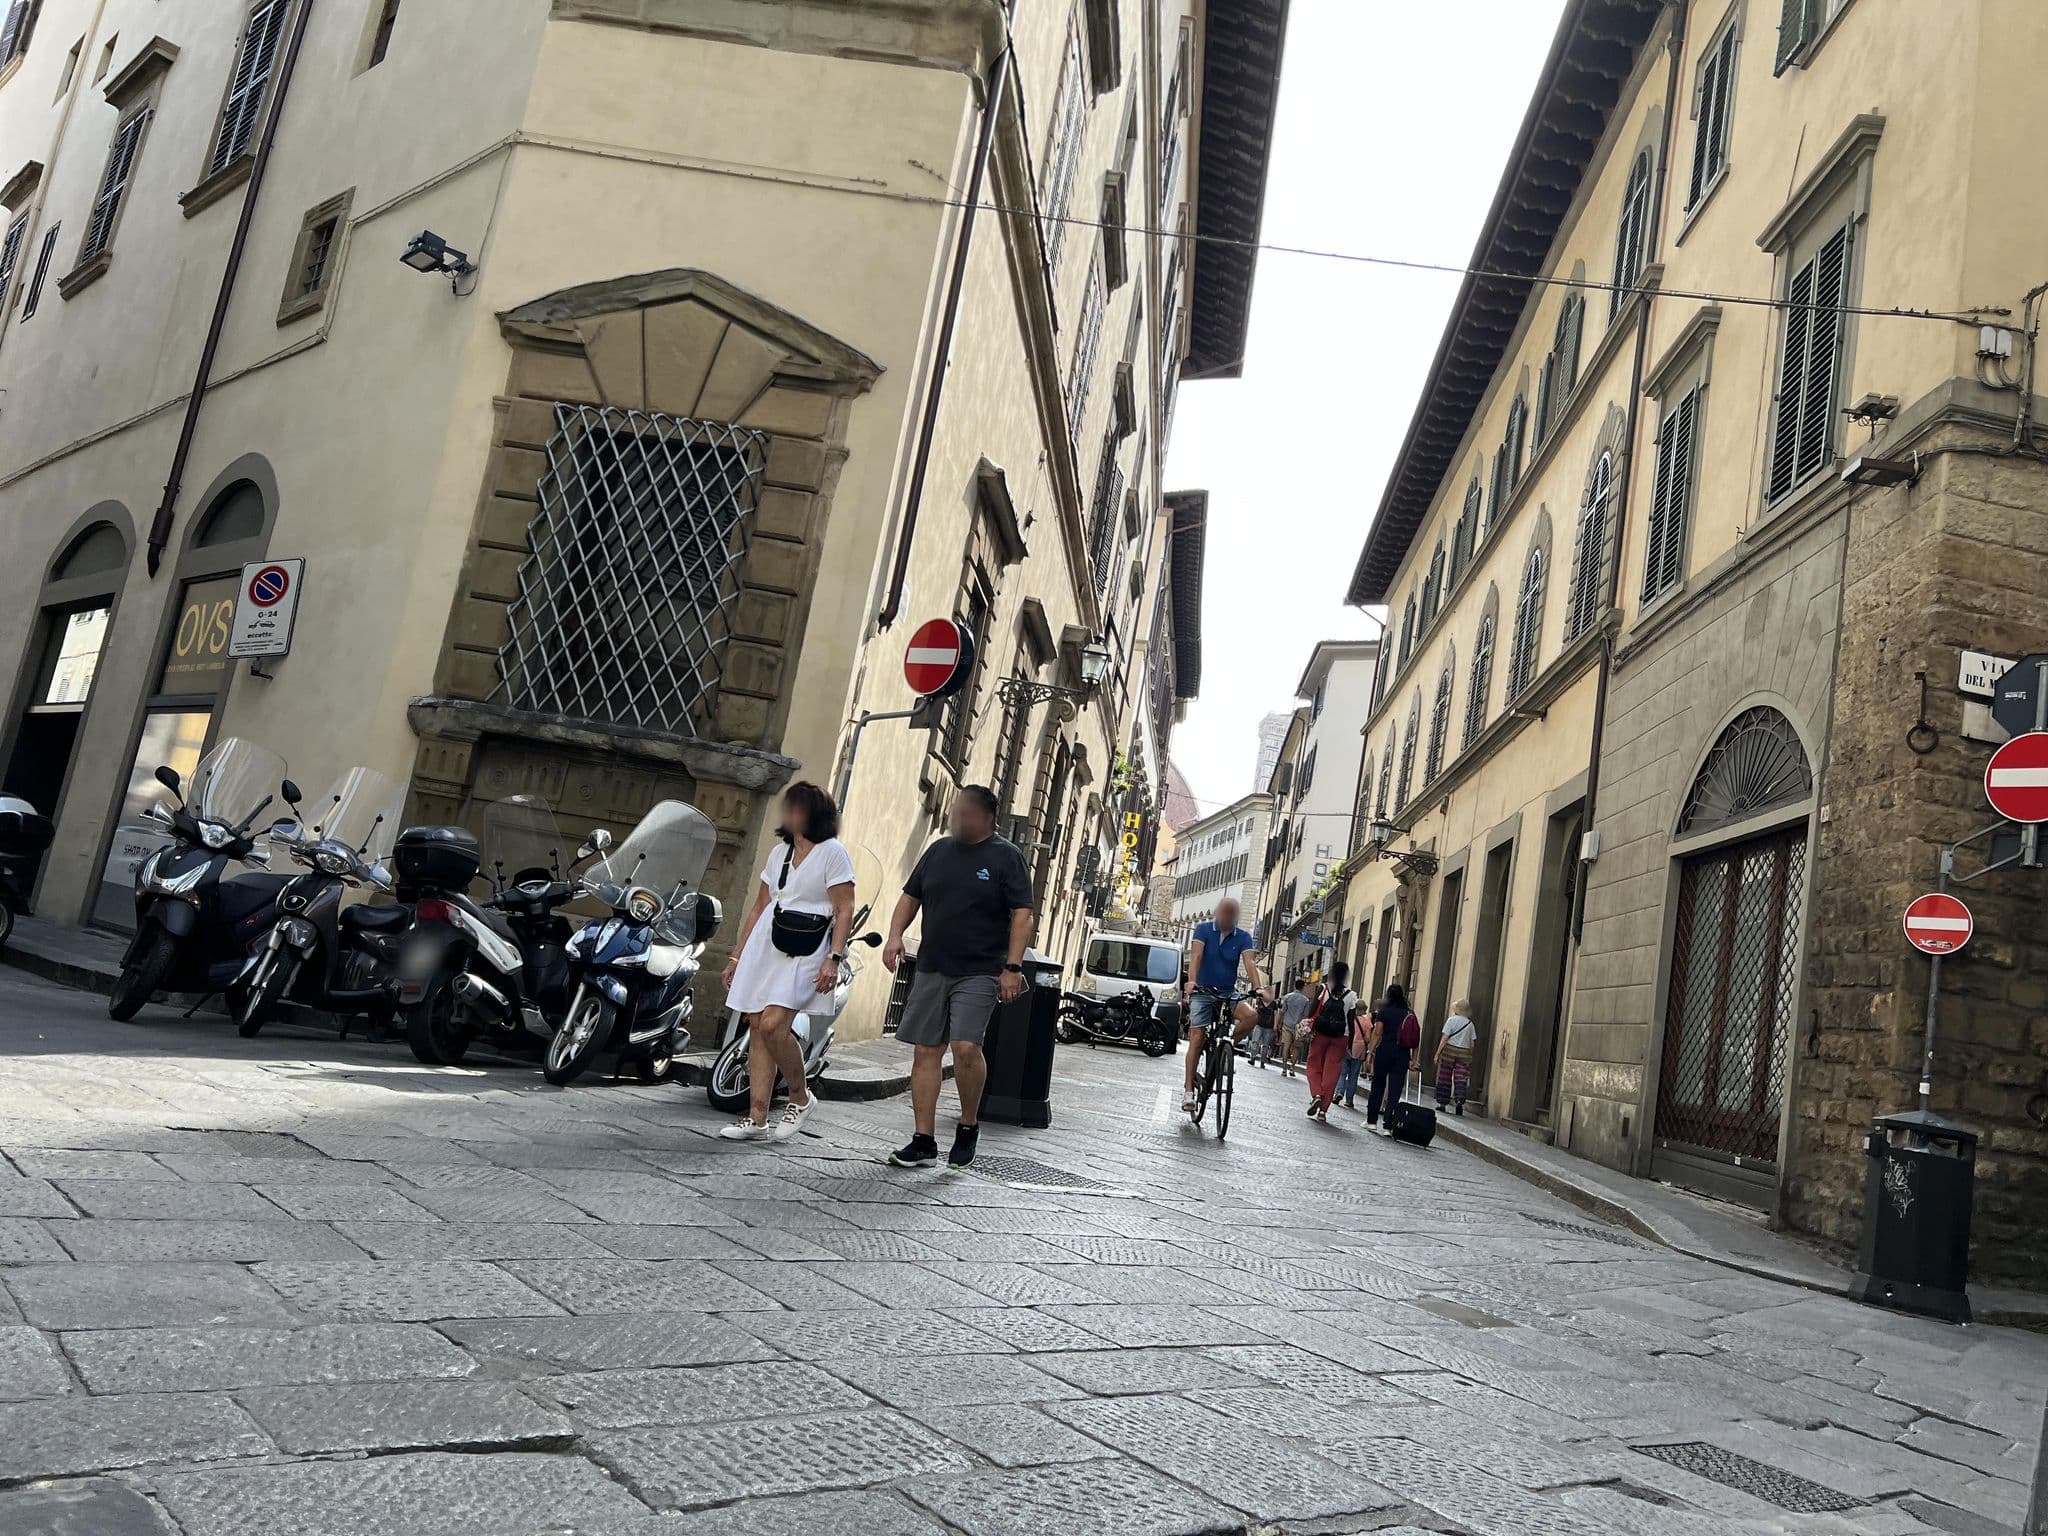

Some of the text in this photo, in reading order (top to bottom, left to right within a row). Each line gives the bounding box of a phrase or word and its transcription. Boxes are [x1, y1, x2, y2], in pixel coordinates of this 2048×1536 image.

[257, 610, 278, 618] 0-24
[176, 599, 234, 657] OVS
[1981, 660, 2006, 676] VIA
[1965, 674, 1986, 688] DEL
